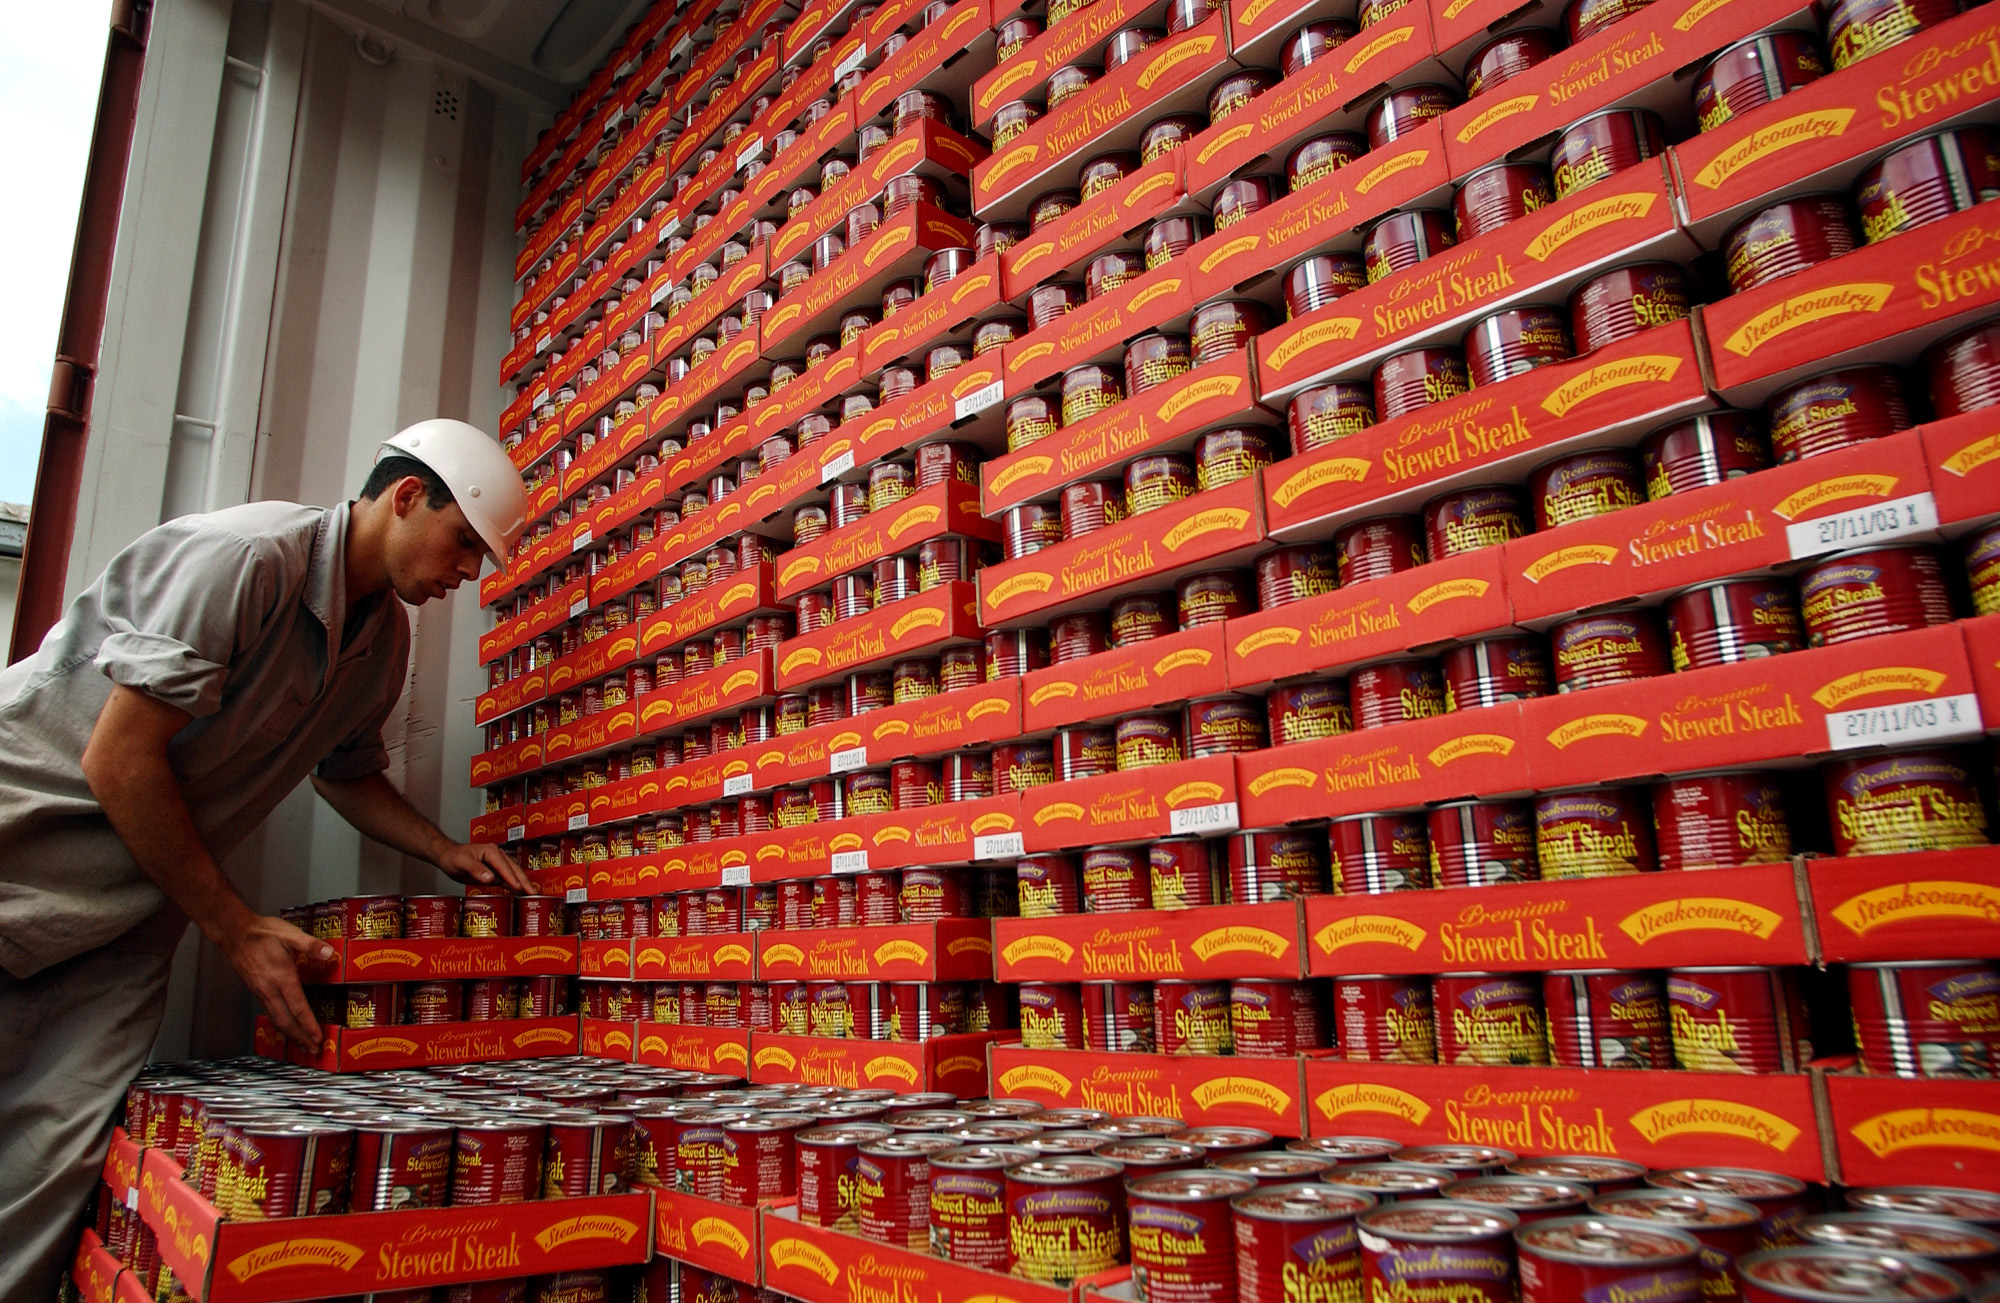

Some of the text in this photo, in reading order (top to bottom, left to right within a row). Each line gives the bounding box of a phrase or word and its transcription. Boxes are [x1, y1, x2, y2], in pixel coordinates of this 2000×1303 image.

[1044, 3, 1125, 72] Stewed Steak
[1352, 32, 1408, 72] Steakcountry
[1562, 31, 1637, 79] Premium
[894, 57, 918, 83] Stewed
[919, 40, 939, 65] Steak
[1145, 41, 1208, 87] Steakcountry
[1549, 32, 1666, 107] Stewed Steak
[984, 65, 1032, 106] Steakcountry
[1260, 73, 1340, 135] Stewed Steak
[1270, 72, 1321, 111] Premium
[1045, 88, 1132, 159] Stewed Steak
[1056, 85, 1109, 131] Premium
[1464, 100, 1530, 141] Steakcountry
[1201, 127, 1249, 163] Steakcountry
[1711, 117, 1839, 187] Steakcountry
[984, 149, 1033, 191] Steakcountry
[1362, 154, 1421, 191] Steakcountry
[814, 178, 868, 233] Stewed Steak
[1266, 192, 1350, 249] Stewed Steak
[1277, 189, 1330, 226] Premium
[1059, 206, 1119, 252] Stewed Steak
[1539, 200, 1643, 257] Steakcountry
[806, 264, 859, 316] Stewed Steak
[1388, 249, 1482, 305] Premium
[1373, 255, 1515, 339] Stewed Steak
[1060, 310, 1122, 354] Stewed Steak
[1741, 290, 1876, 351] Steakcountry
[1276, 322, 1350, 368] Steakcountry
[1164, 379, 1232, 420] Steakcountry
[1556, 361, 1667, 412] Steakcountry
[1071, 409, 1130, 449] Premium
[1397, 397, 1496, 450] Premium
[1808, 398, 1858, 424] Steak
[1060, 415, 1150, 476] Stewed Steak
[1382, 406, 1532, 484] Stewed Steak
[995, 460, 1047, 492] Steakcountry
[1282, 462, 1362, 505] Steakcountry
[1787, 480, 1884, 518] Steakcountry
[1170, 511, 1241, 551] Steakcountry
[1629, 509, 1765, 568] Stewed Steak
[1645, 502, 1733, 540] Premium
[1818, 505, 1899, 544] 27/11/03
[824, 532, 883, 575] Stewed Steak
[1061, 540, 1155, 595] Stewed Steak
[1072, 533, 1134, 569] Premium
[1534, 547, 1608, 580] Steakcountry
[993, 575, 1046, 606] Steakcountry
[1835, 582, 1886, 606] Steak
[1309, 604, 1401, 648] Stewed Steak
[1320, 597, 1380, 627] Premium
[826, 628, 886, 669] Stewed Steak
[1558, 637, 1643, 666] Stewed Steak
[1083, 667, 1149, 701] Stewed Steak
[1676, 681, 1772, 716] Premium
[1827, 671, 1931, 704] Steakcountry
[1559, 716, 1637, 748] Steakcountry
[1660, 693, 1802, 744] Stewed Steak
[1846, 701, 1937, 737] 27/11/03
[1325, 754, 1422, 793] Stewed Steak
[1335, 745, 1398, 771] Premium
[1090, 796, 1161, 827] Stewed Steak
[1178, 805, 1220, 827] 27/11/03
[1838, 797, 1928, 840] Stewed
[915, 823, 967, 848] Stewed Steak
[1580, 821, 1638, 858] Steak
[1326, 917, 1414, 950] Steakcountry
[1456, 901, 1568, 929] Premium
[1636, 901, 1764, 939] Steakcountry
[817, 938, 857, 954] Premium
[878, 942, 922, 964] Steakcountry
[1010, 937, 1065, 962] Steakcountry
[1093, 925, 1161, 947] Premium
[1201, 929, 1278, 959] Steakcountry
[1440, 915, 1608, 963] Stewed Steak
[429, 952, 507, 974] Stewed Steak
[809, 949, 869, 976] Stewed Steak
[1083, 939, 1184, 975] Stewed Steak
[1680, 1008, 1740, 1051] Steak
[425, 1037, 505, 1062] Stewed Steak
[801, 1057, 858, 1089] Stewed Steak
[869, 1058, 912, 1082] Steakcountry
[1007, 1067, 1063, 1094] Steakcountry
[1092, 1066, 1159, 1083] Premium
[1080, 1078, 1183, 1119] Stewed Steak
[1201, 1078, 1279, 1111] Steakcountry
[1327, 1084, 1417, 1122] Steakcountry
[1462, 1083, 1580, 1107] Premium
[1445, 1099, 1617, 1154] Stewed Steak
[1647, 1101, 1781, 1145] Steakcountry
[967, 1196, 1003, 1215] Steak
[398, 1218, 503, 1247] Premium
[545, 1217, 628, 1248] Steakcountry
[660, 1213, 687, 1252] Steak
[696, 1219, 743, 1251] Steakcountry
[1010, 1216, 1070, 1260] Stewed
[1077, 1214, 1121, 1258] Steak
[1162, 1232, 1207, 1255] Steak
[241, 1240, 350, 1278] Steakcountry
[376, 1232, 520, 1281] Stewed Steak
[777, 1240, 831, 1278] Steakcountry
[859, 1253, 927, 1281] Premium
